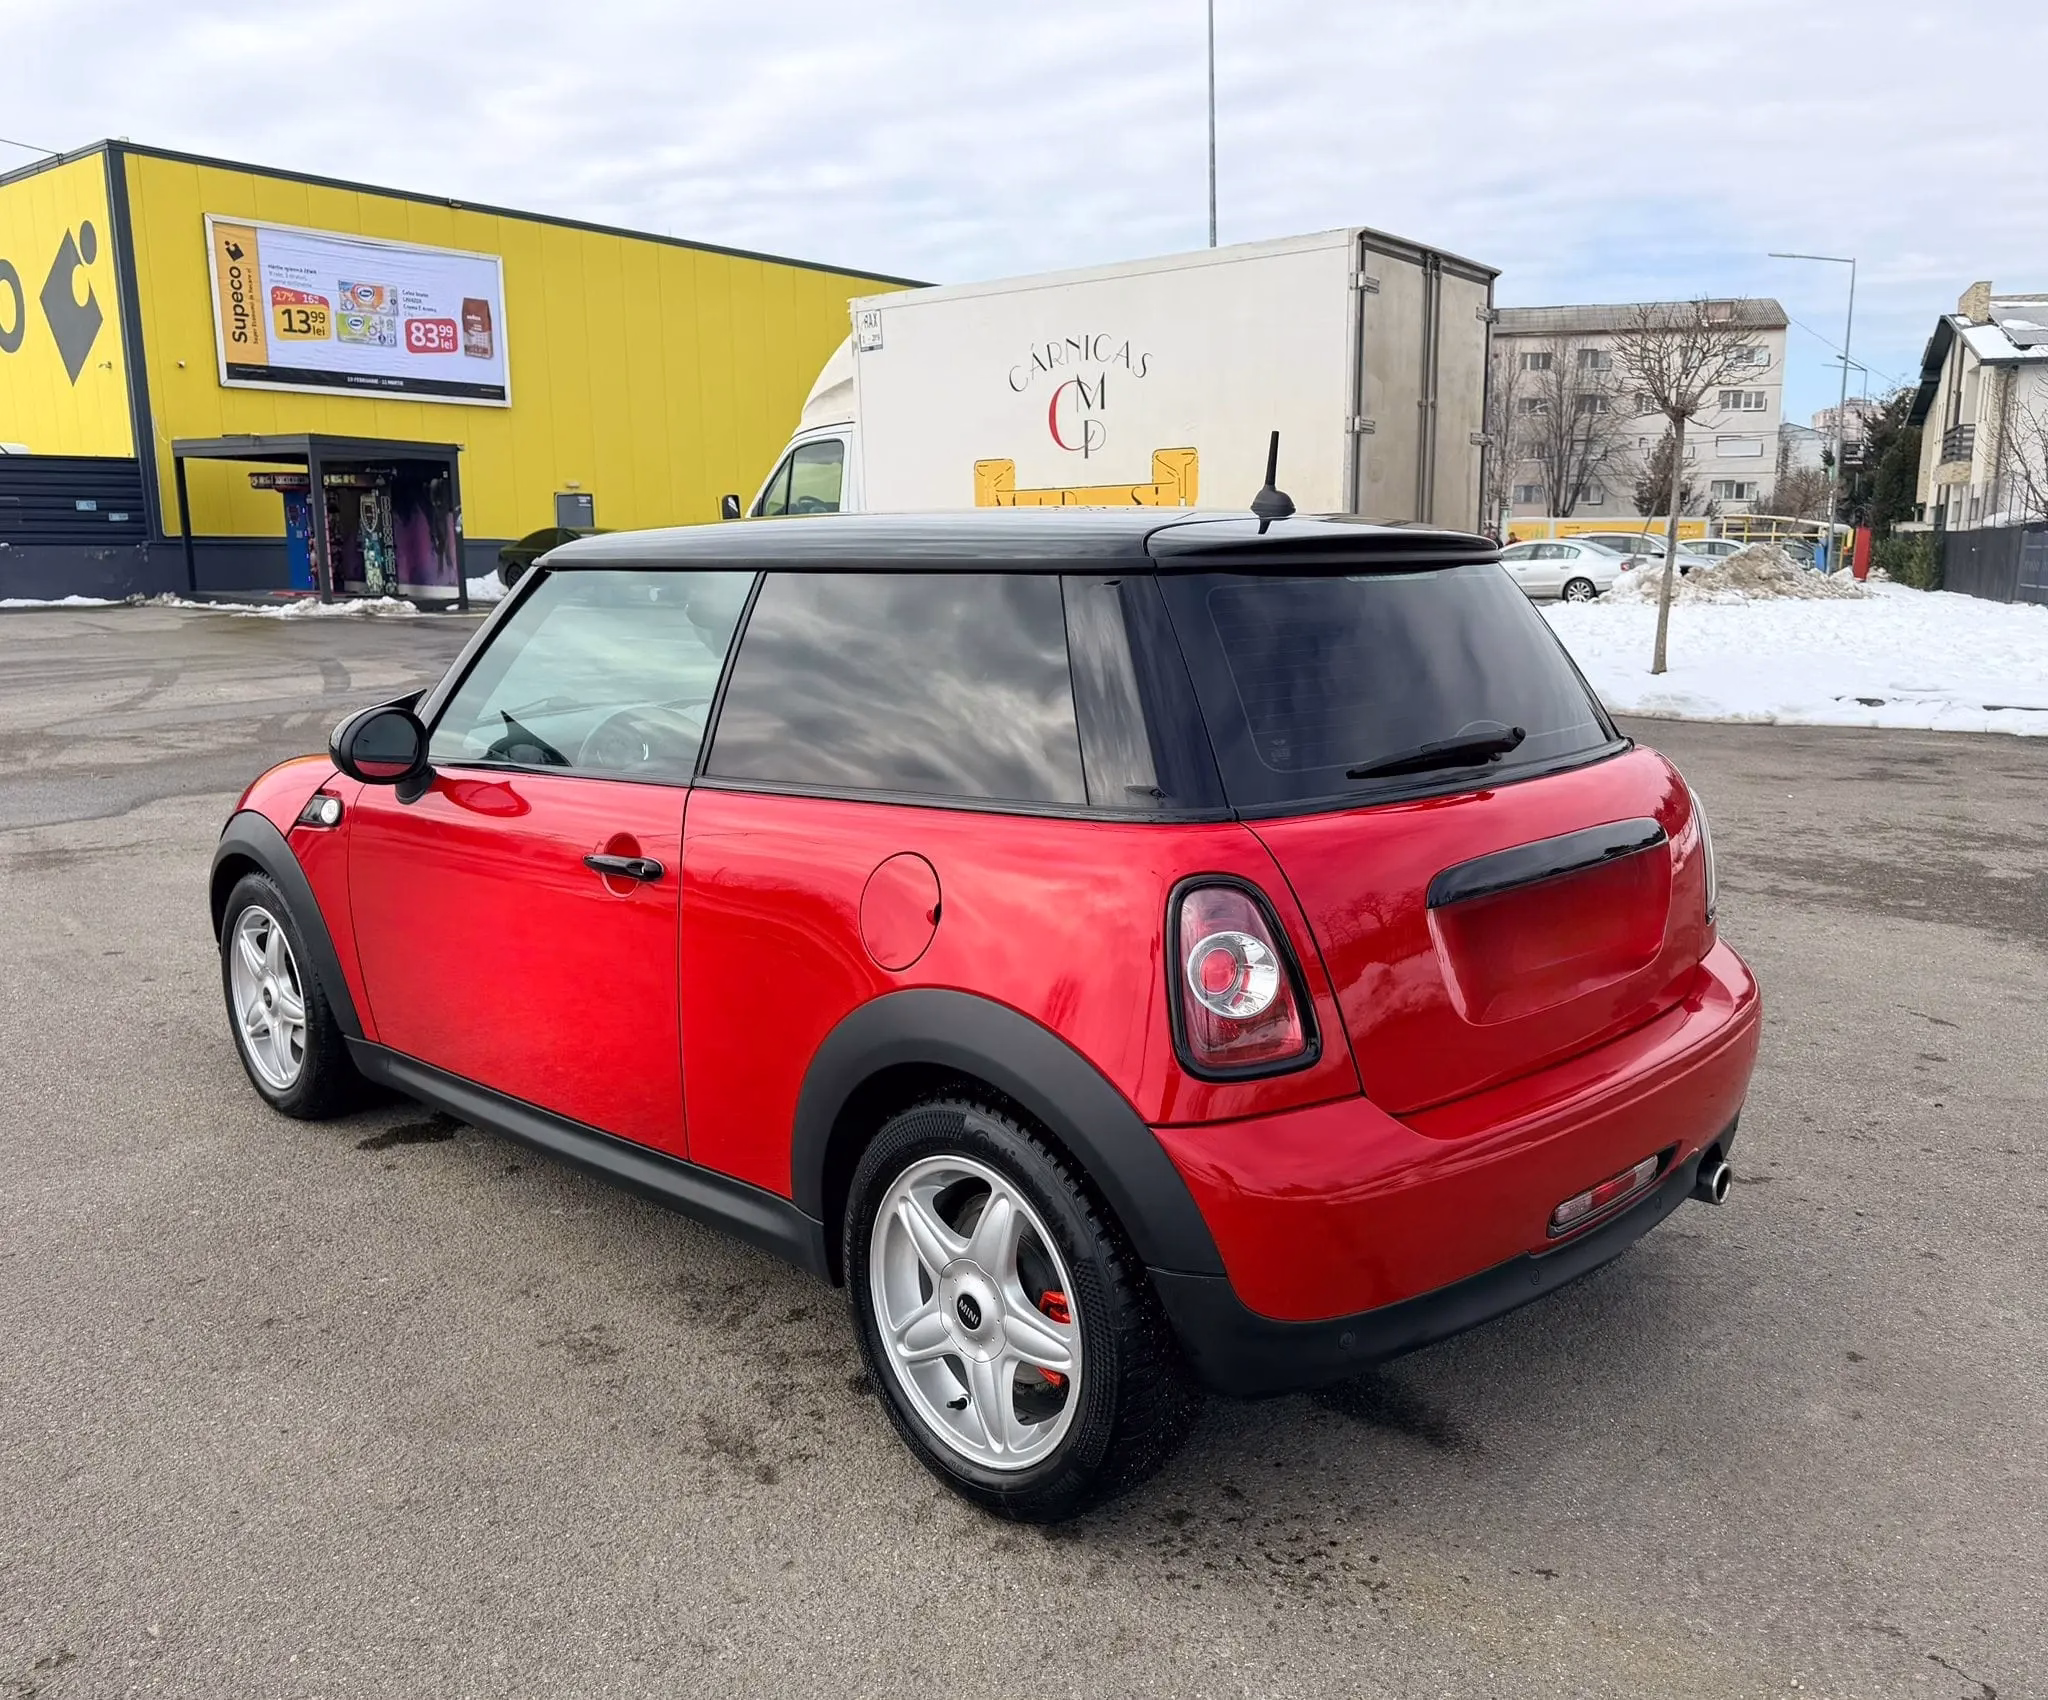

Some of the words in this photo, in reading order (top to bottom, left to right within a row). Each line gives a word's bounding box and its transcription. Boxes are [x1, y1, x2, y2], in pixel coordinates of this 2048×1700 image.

[229, 266, 249, 343] Supeco
[273, 291, 296, 302] -17%
[312, 325, 325, 336] lei
[440, 339, 453, 350] lei
[1009, 333, 1153, 392] CÁRNICAS
[958, 1299, 979, 1325] MINI
